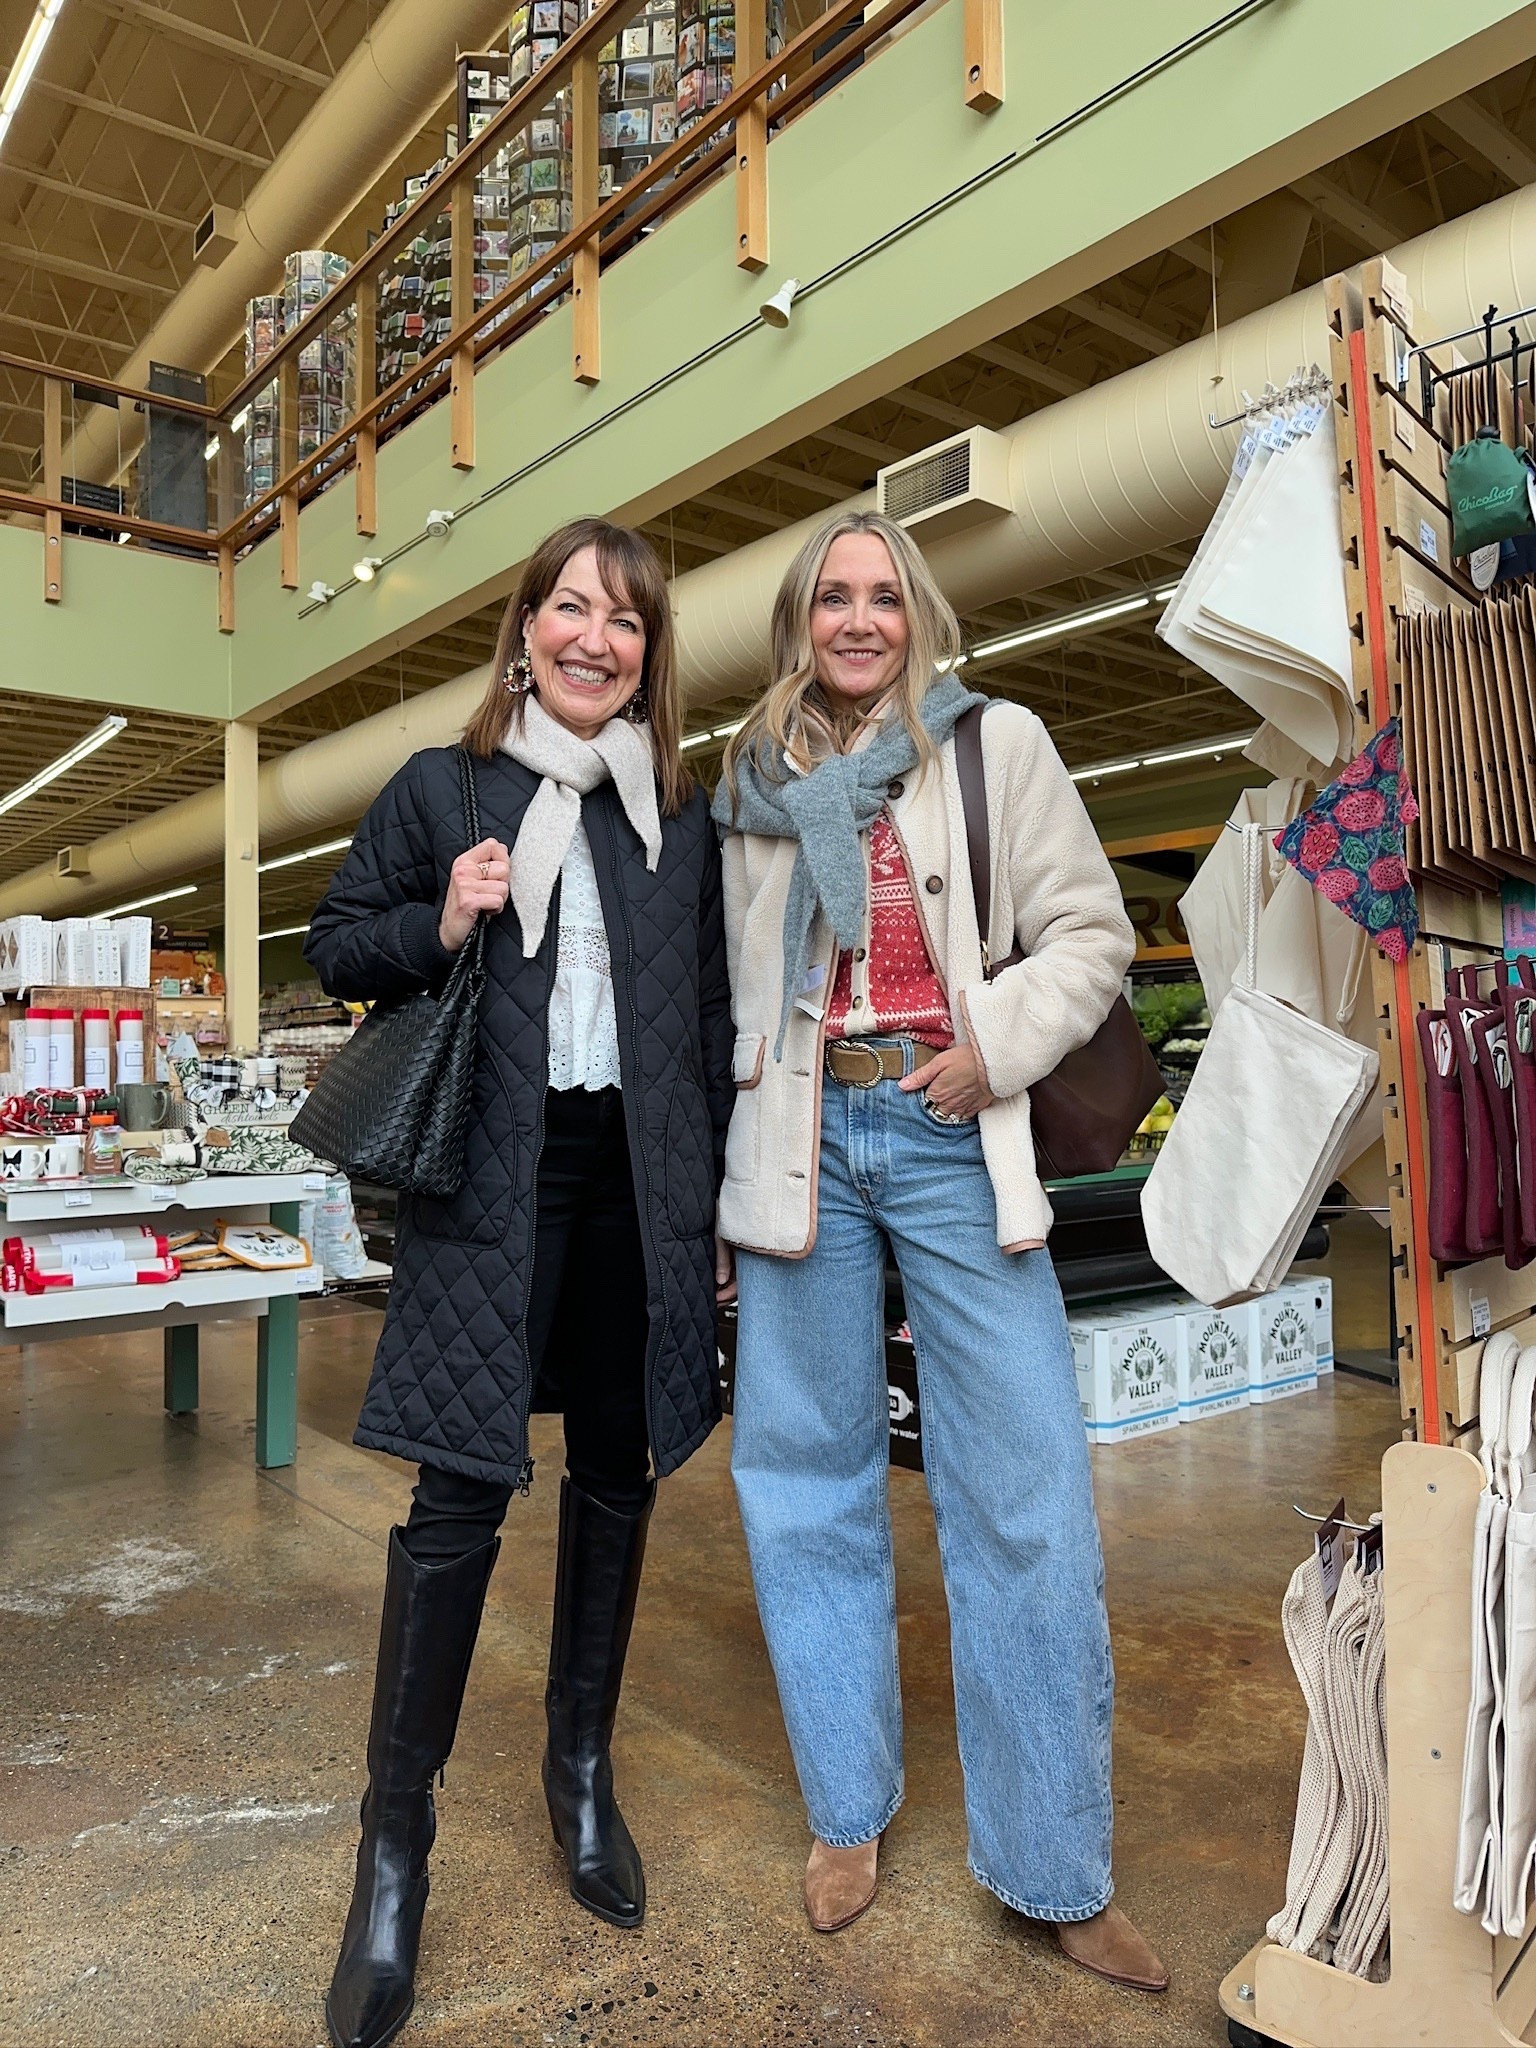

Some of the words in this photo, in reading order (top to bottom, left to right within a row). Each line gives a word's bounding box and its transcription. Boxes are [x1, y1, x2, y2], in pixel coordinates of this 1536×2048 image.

[1457, 484, 1518, 513] ChicoBag
[1509, 907, 1517, 937] Washable
[159, 924, 169, 940] 2
[220, 1110, 280, 1125] dishtowels
[1283, 1300, 1292, 1308] THE
[1212, 1312, 1222, 1320] THE
[1270, 1307, 1307, 1340] MOUNTAIN
[1138, 1327, 1148, 1336] THE
[1199, 1320, 1238, 1354] MOUNTAIN
[1122, 1335, 1166, 1372] MOUNTAIN
[1275, 1347, 1303, 1365] VALLEY
[1204, 1361, 1234, 1381] VALLEY
[1128, 1380, 1161, 1400] VALLEY
[1270, 1384, 1294, 1397] SPARKLING
[1294, 1380, 1309, 1390] WATER
[1198, 1400, 1225, 1414] SPARKLING
[1225, 1395, 1241, 1407] WATER
[1121, 1420, 1151, 1436] SPARKLING
[1151, 1415, 1169, 1428] WATER
